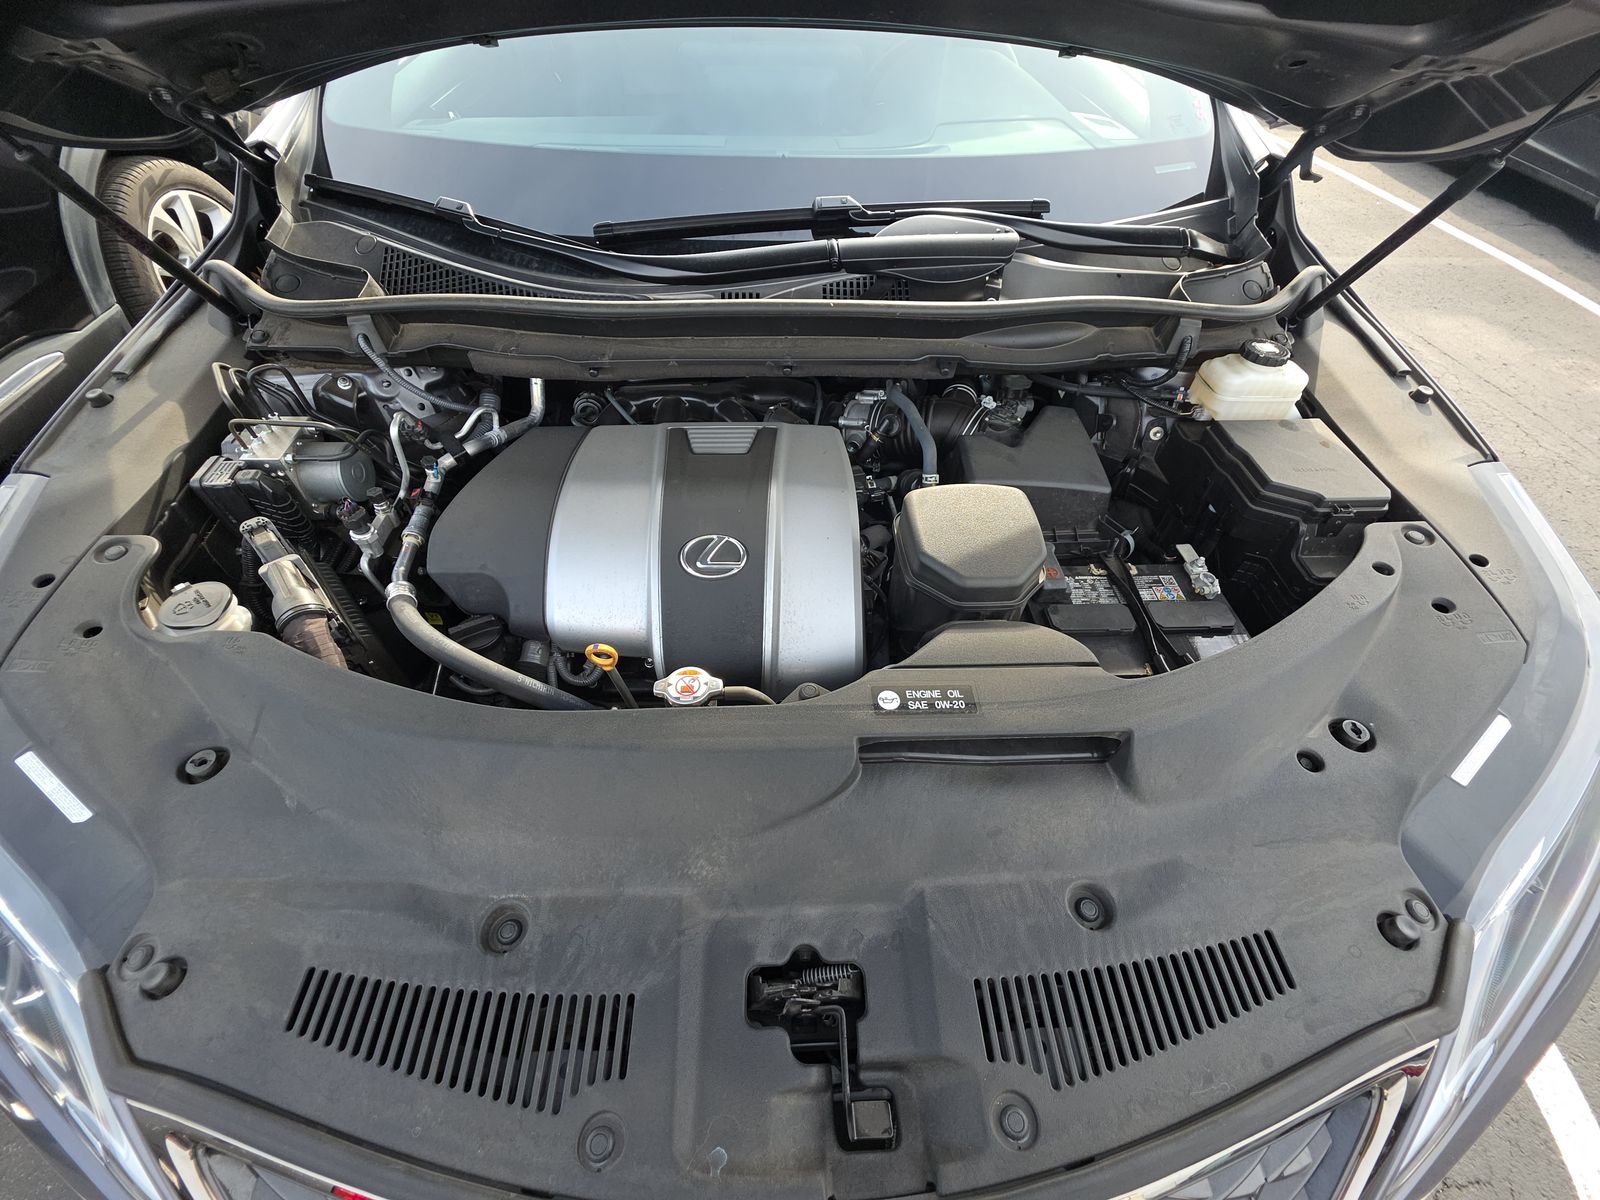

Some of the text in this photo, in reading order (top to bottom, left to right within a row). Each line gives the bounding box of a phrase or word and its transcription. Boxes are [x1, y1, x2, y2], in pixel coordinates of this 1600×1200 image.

[905, 690, 964, 698] ENGINE OIL
[907, 700, 966, 709] SAE 0W-20
